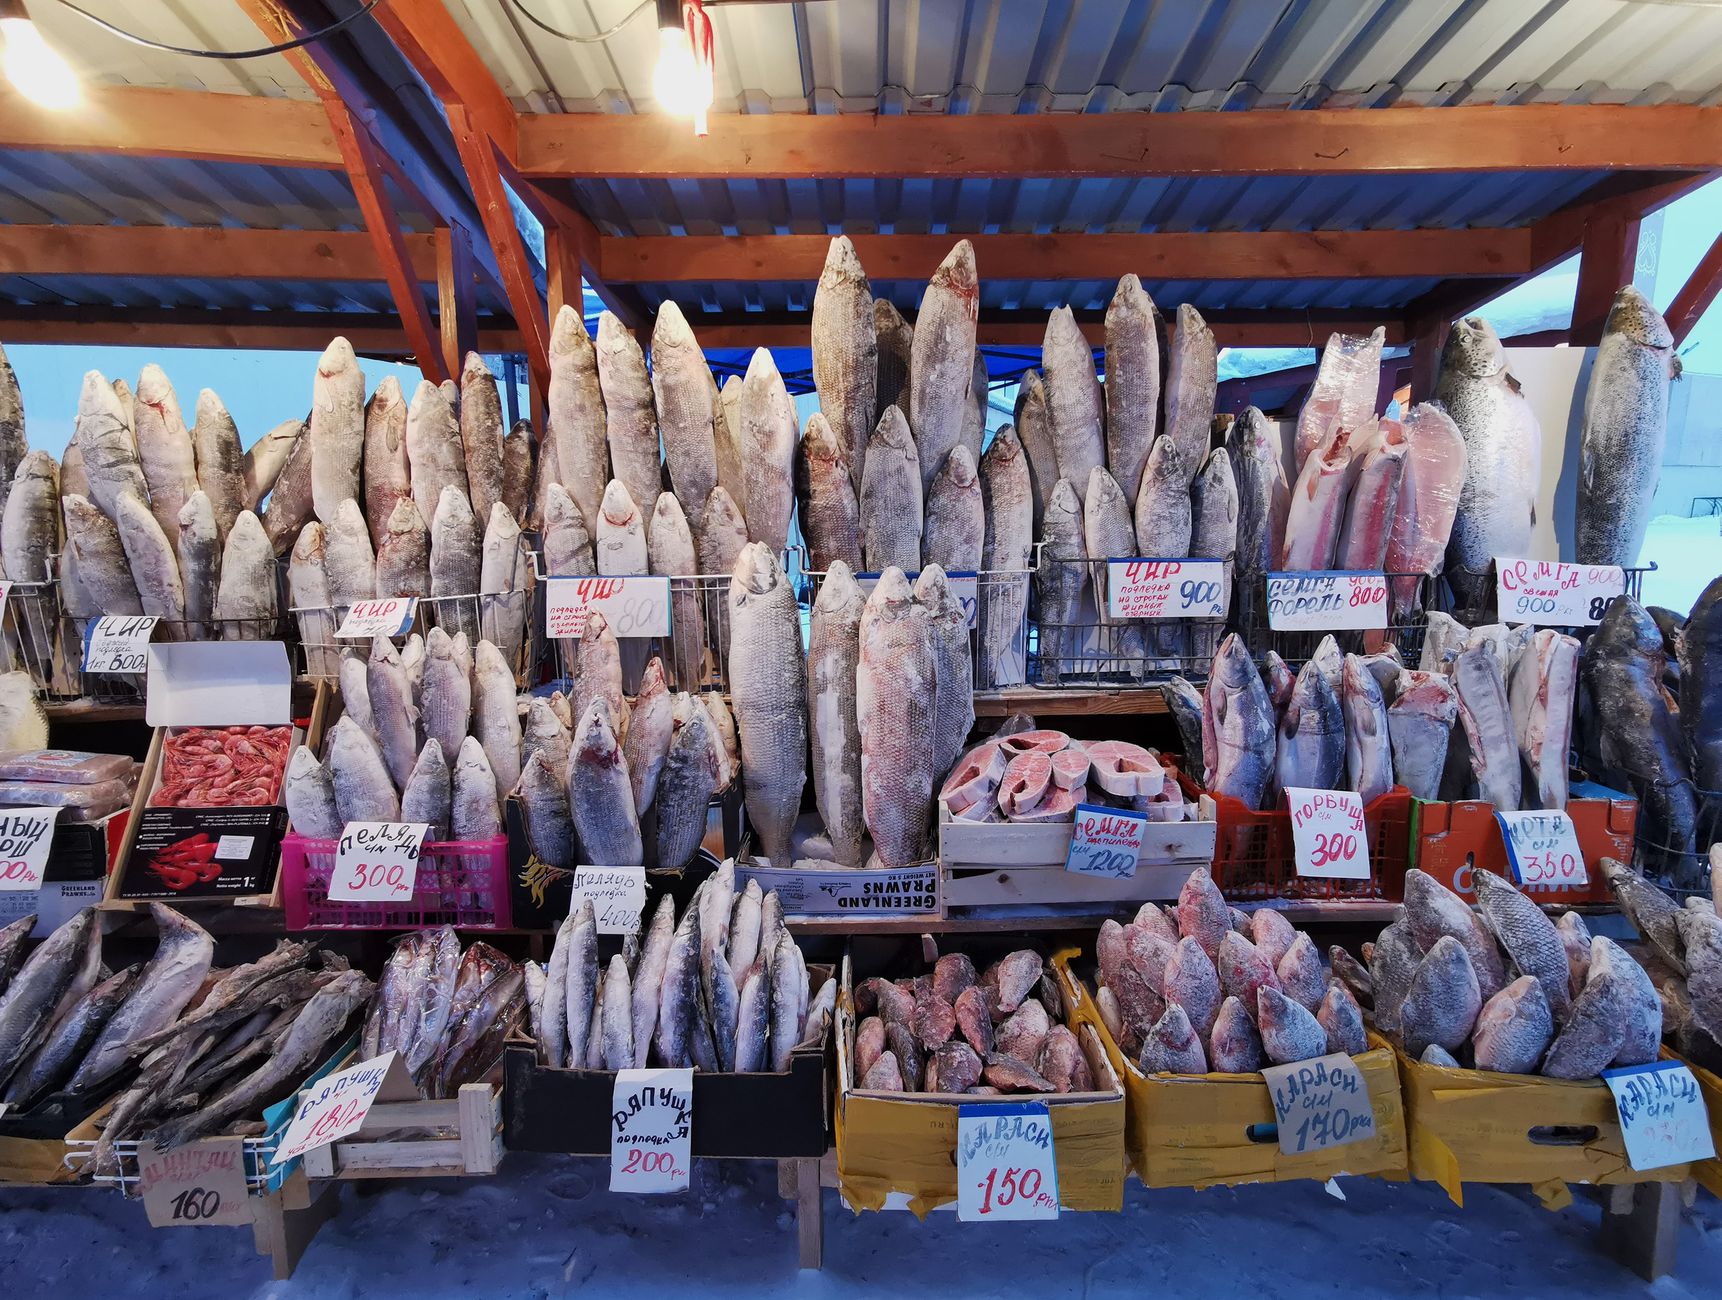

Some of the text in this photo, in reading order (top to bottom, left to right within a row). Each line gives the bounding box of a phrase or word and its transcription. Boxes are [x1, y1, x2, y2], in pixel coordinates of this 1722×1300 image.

[1125, 561, 1182, 585] ЧИР
[1180, 580, 1222, 609] 900
[1268, 594, 1345, 617] ФОРЕЛЬ
[1349, 586, 1386, 607] 800
[1516, 595, 1556, 615] 900
[353, 601, 397, 619] ЧИР
[98, 617, 156, 638] ЧИР
[1080, 849, 1136, 872] 1200
[1310, 832, 1357, 867] 300
[348, 863, 404, 891] 300
[1523, 851, 1576, 882] 350
[244, 876, 250, 888] 1
[863, 878, 936, 894] PRAWNS
[838, 894, 937, 909] GREENLAND
[305, 1098, 358, 1140] 180
[613, 1086, 693, 1139] РЯПУШКА
[1295, 1108, 1351, 1152] 170
[621, 1148, 675, 1174] 200
[978, 1166, 1042, 1214] 150
[170, 1186, 220, 1221] 160
